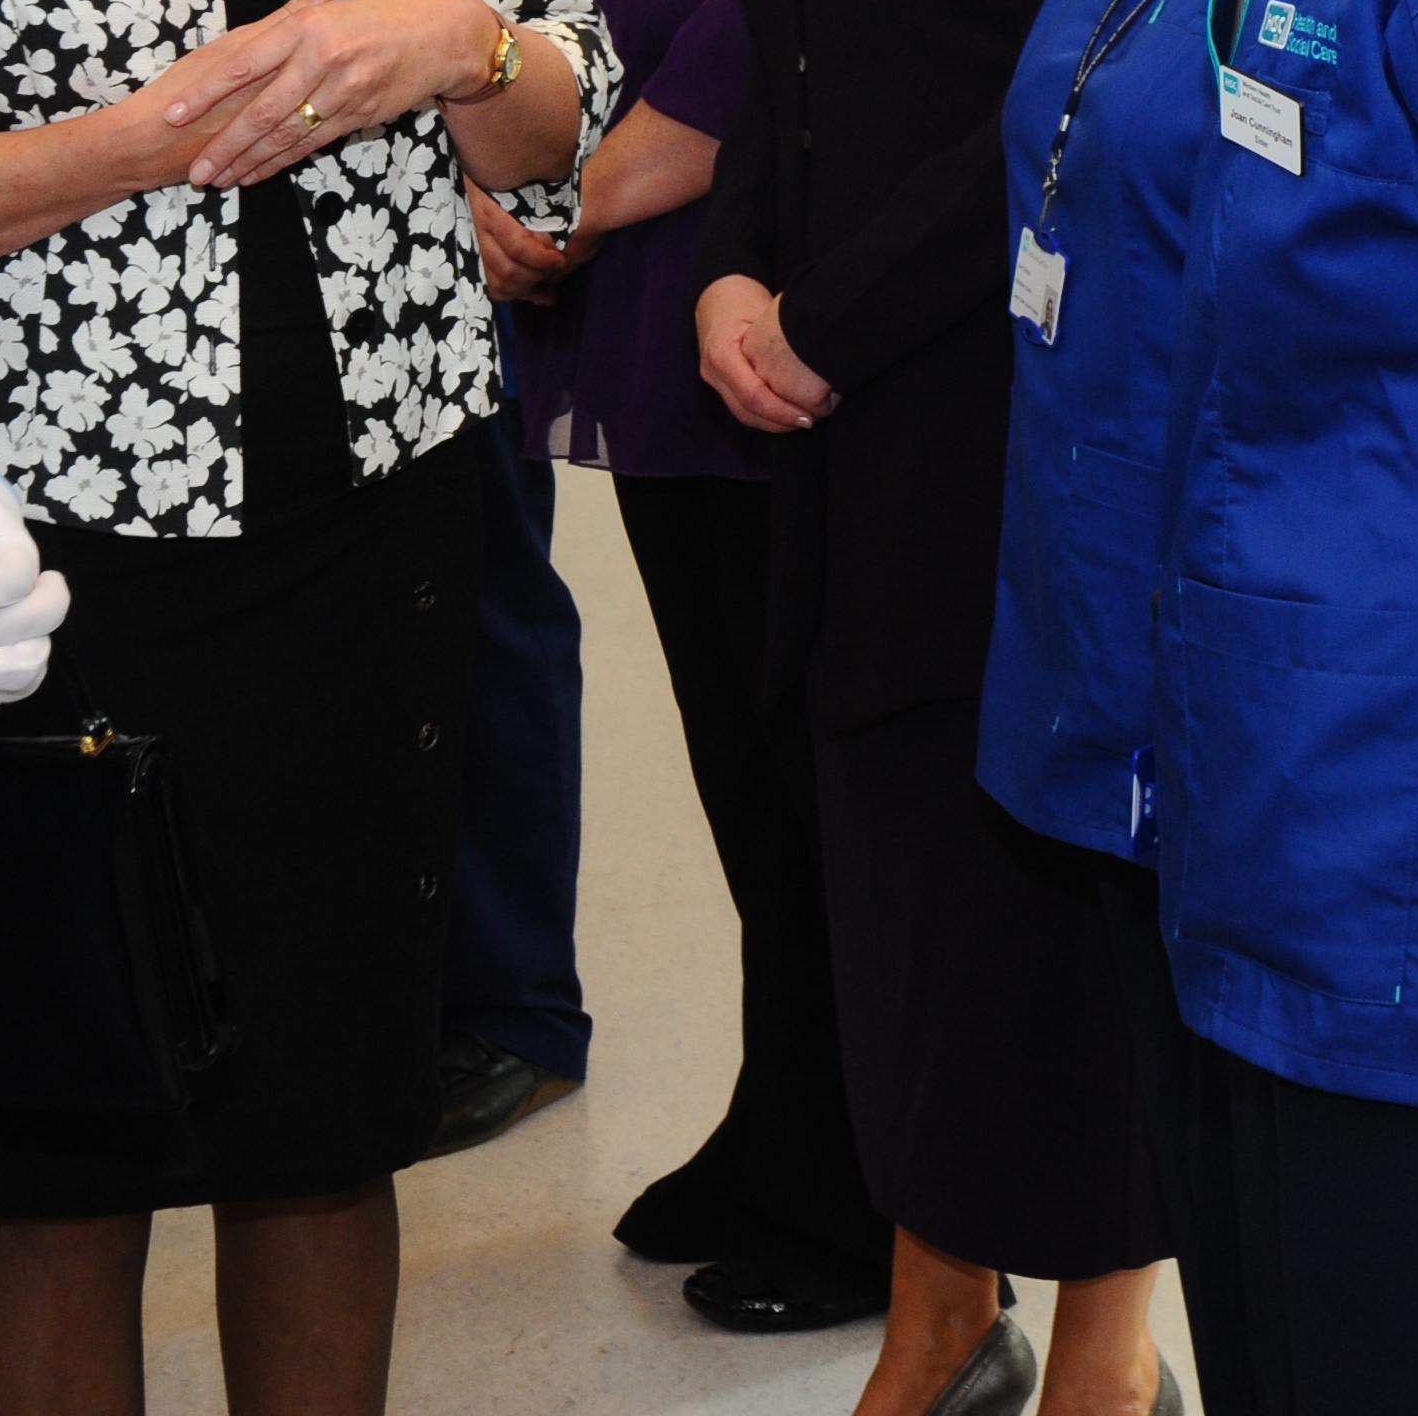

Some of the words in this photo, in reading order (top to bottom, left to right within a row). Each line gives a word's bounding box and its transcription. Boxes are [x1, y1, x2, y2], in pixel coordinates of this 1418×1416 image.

[1317, 22, 1337, 40] and
[1312, 41, 1337, 64] Care
[1230, 109, 1247, 124] Joan
[1249, 118, 1292, 147] Cunningham
